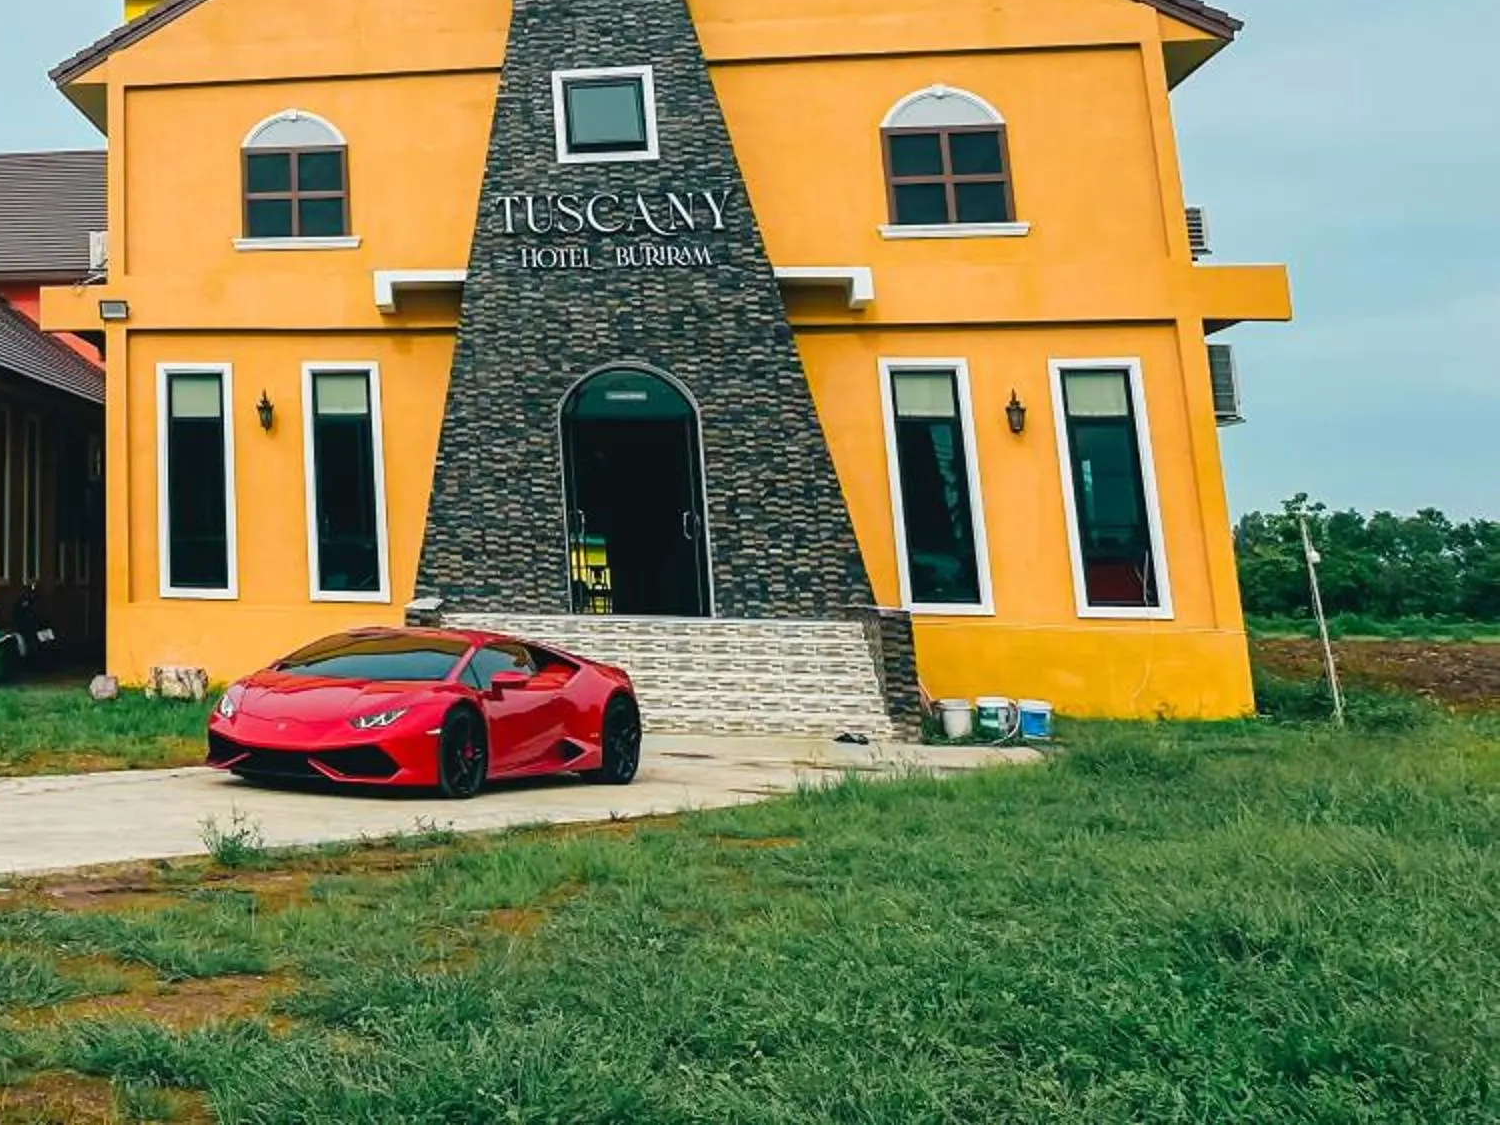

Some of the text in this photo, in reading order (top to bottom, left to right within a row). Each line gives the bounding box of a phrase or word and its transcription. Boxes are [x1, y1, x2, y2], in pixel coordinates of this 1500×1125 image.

[496, 190, 730, 236] TUSCANY
[521, 245, 713, 268] HOTEL BURIRAM
